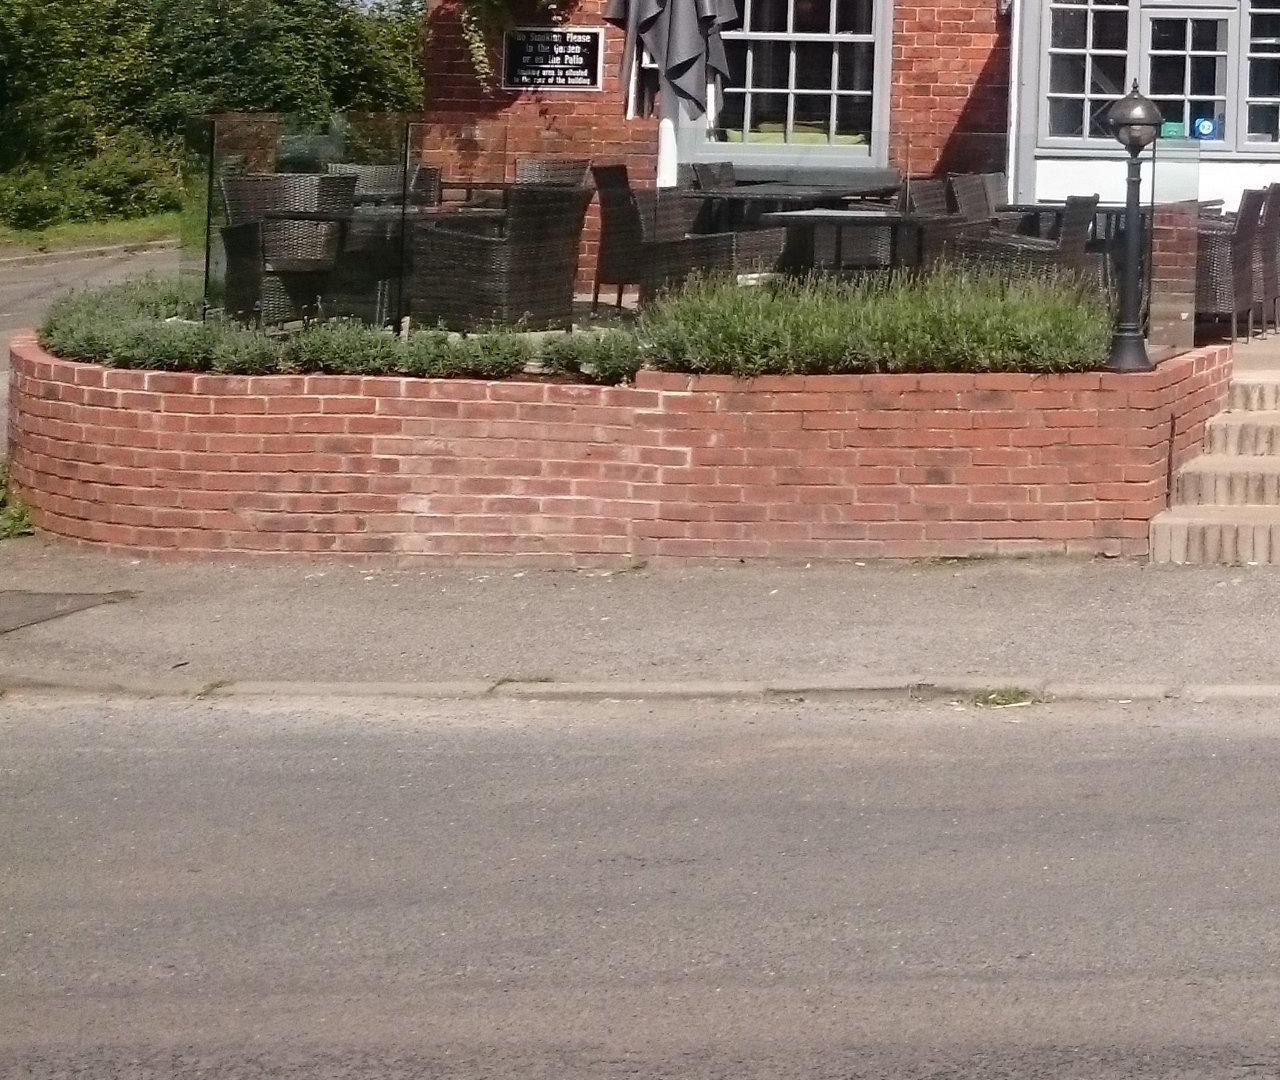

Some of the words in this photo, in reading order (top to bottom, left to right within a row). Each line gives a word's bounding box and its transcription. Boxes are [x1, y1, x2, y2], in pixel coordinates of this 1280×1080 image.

[566, 33, 591, 42] Please
[553, 43, 581, 55] Garden
[548, 54, 561, 64] the
[564, 54, 584, 65] Patio
